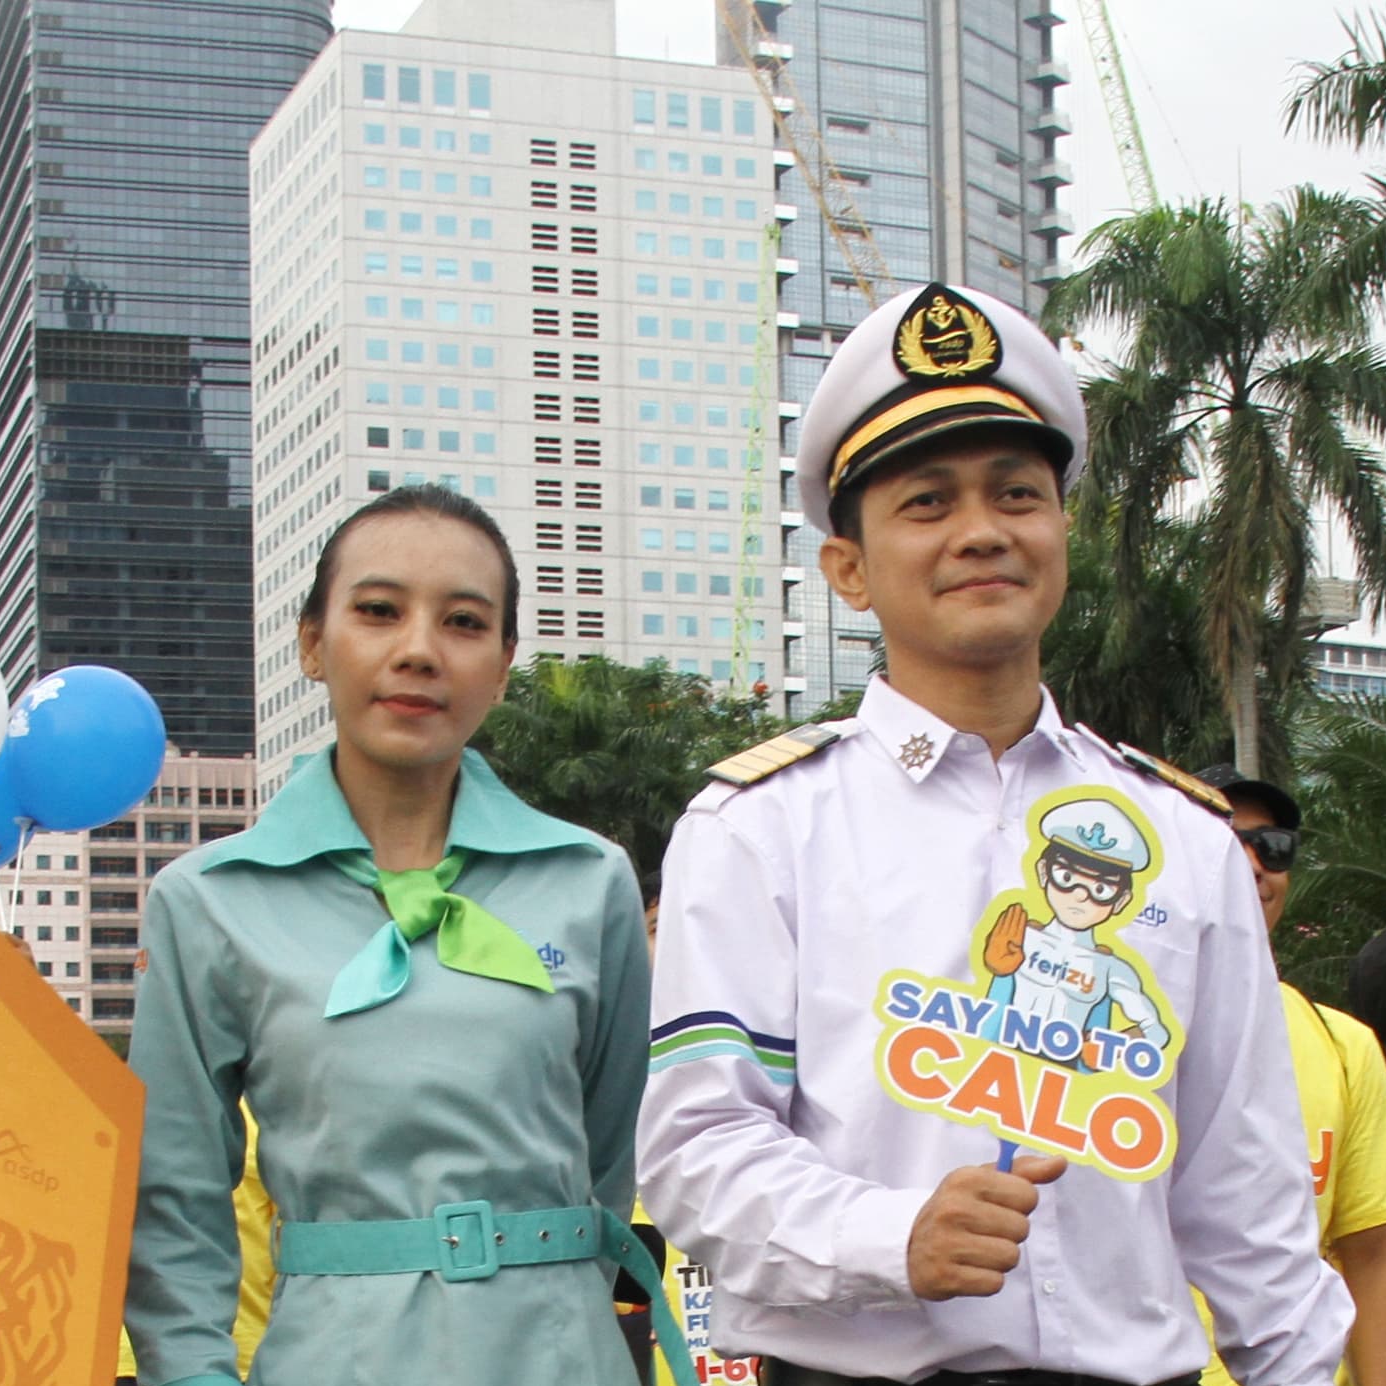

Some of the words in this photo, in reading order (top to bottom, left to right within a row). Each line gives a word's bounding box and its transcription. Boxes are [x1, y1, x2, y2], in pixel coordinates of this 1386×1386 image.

[1028, 951, 1096, 993] ferizy
[887, 982, 994, 1036] SAY
[1003, 1010, 1080, 1058] NO
[1093, 1032, 1162, 1078] TO
[888, 1026, 1164, 1170] CALO
[4, 1159, 59, 1192] asdp
